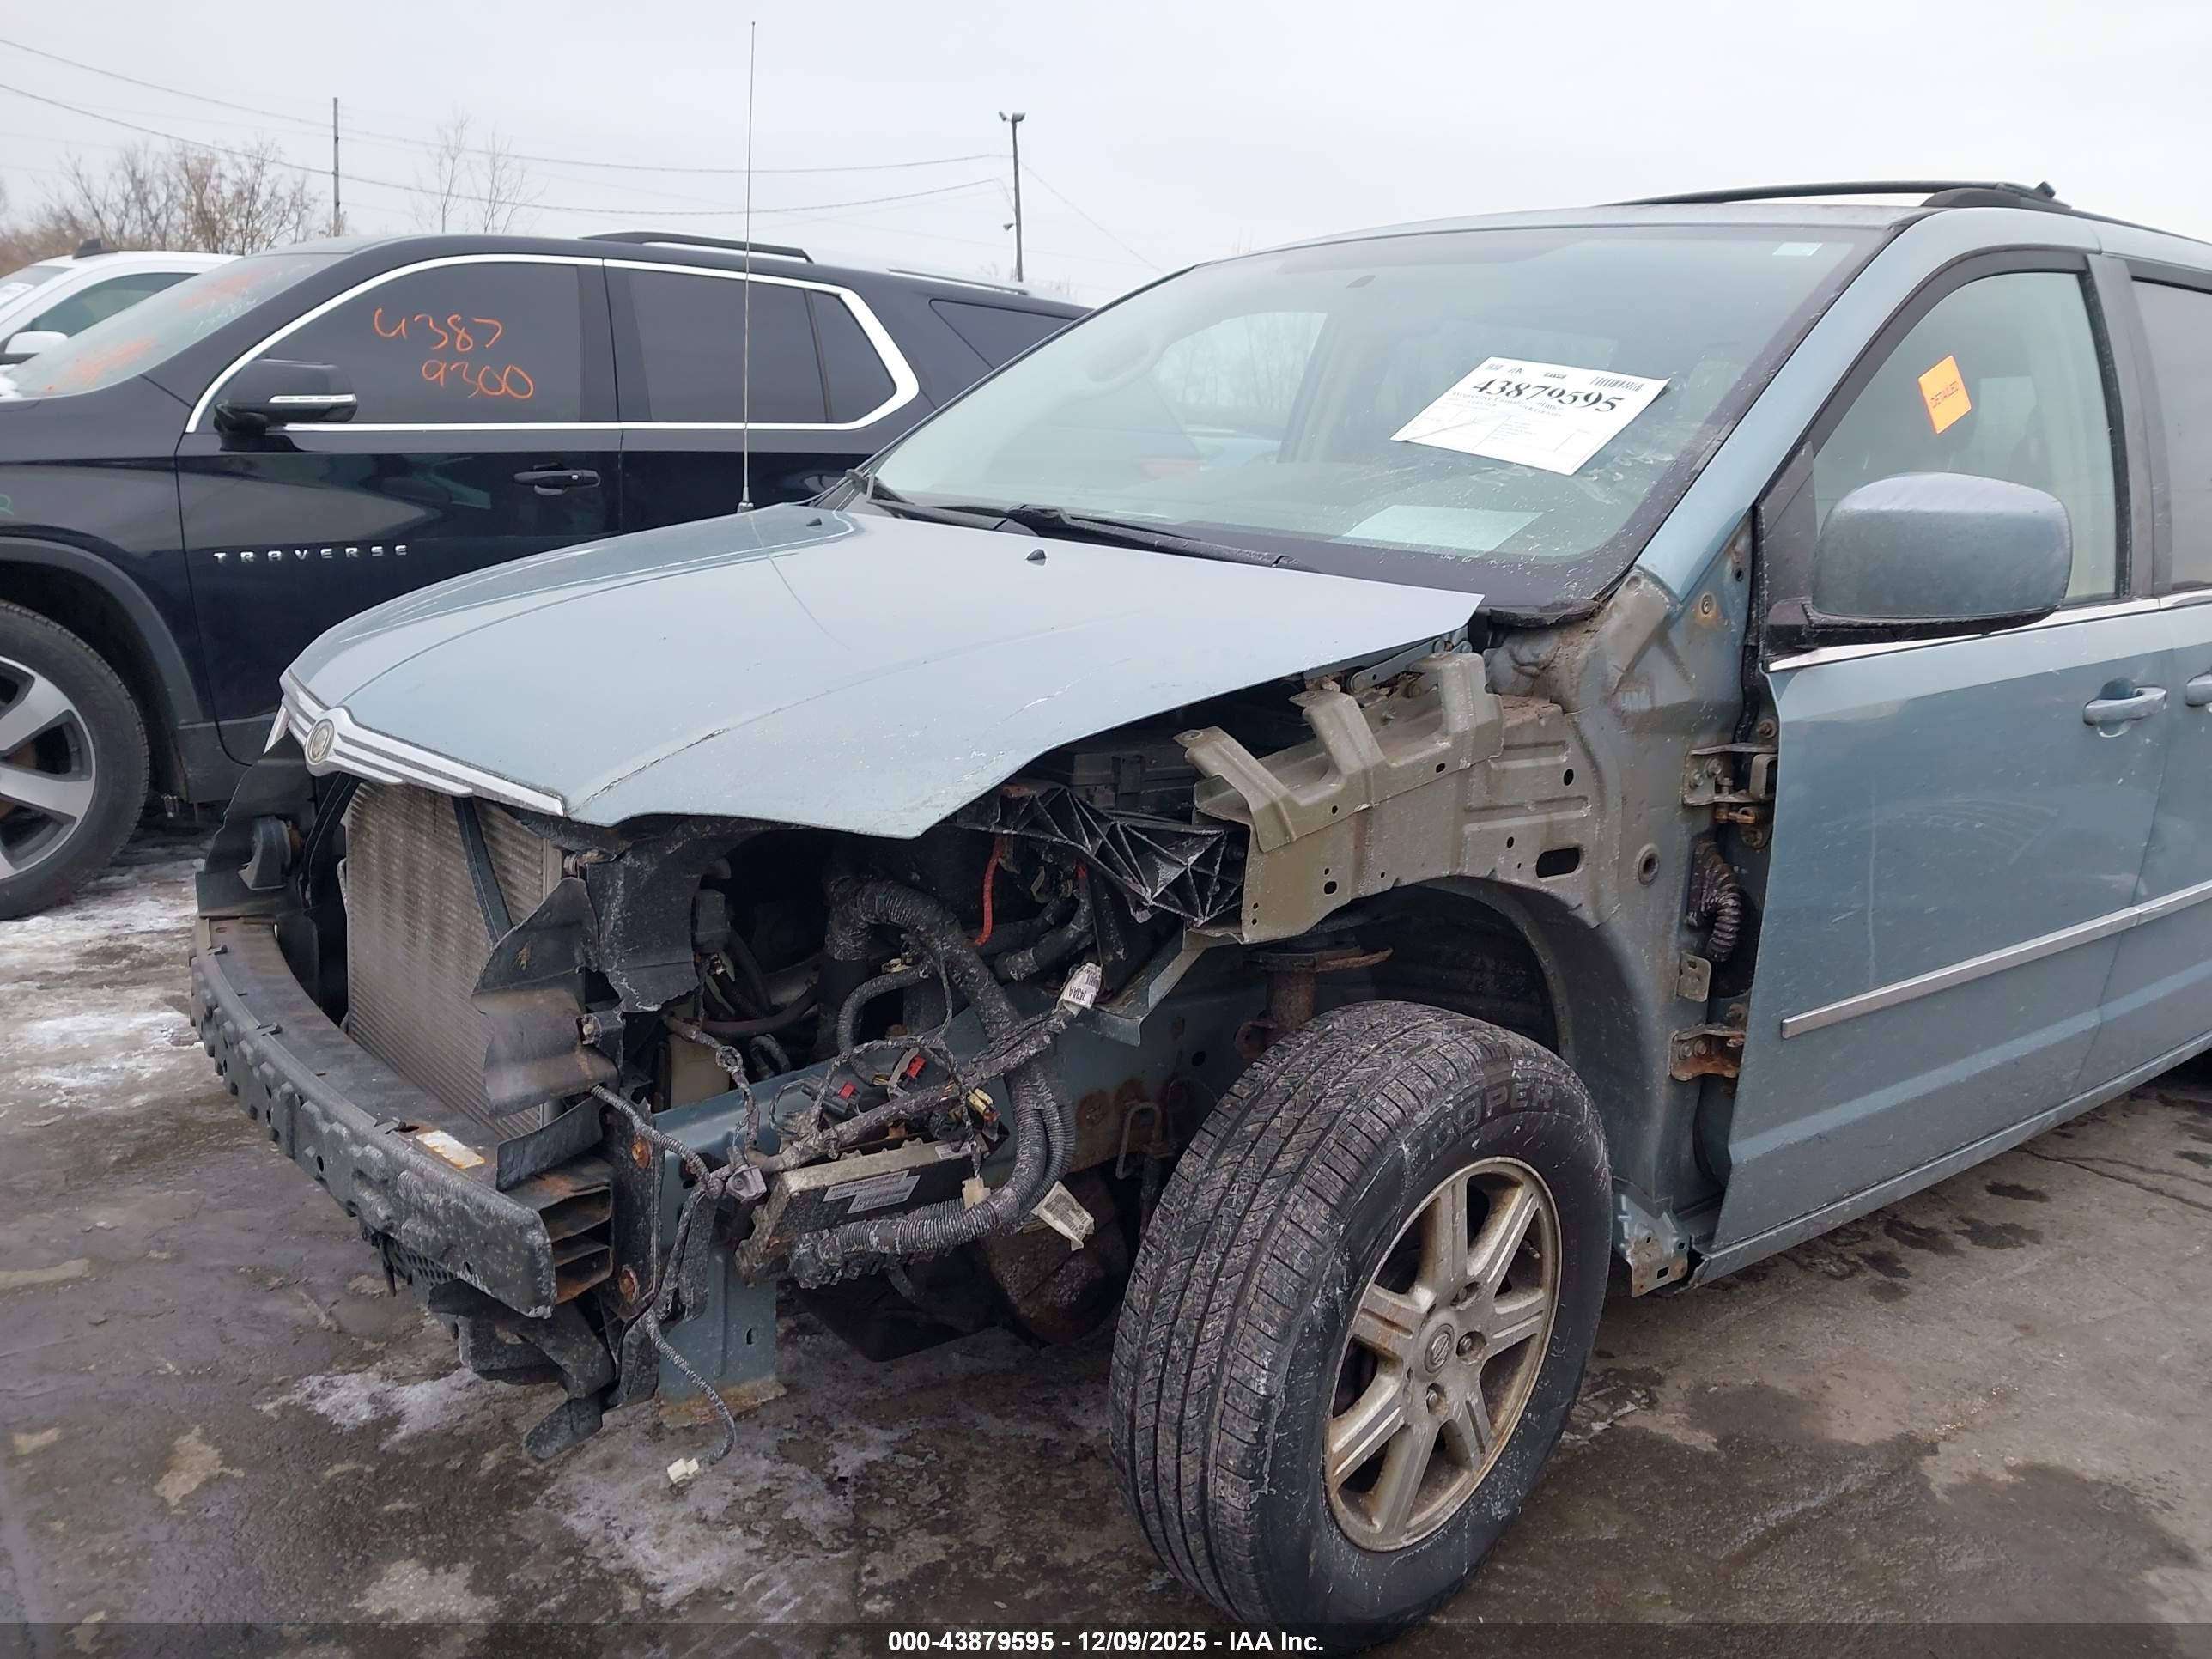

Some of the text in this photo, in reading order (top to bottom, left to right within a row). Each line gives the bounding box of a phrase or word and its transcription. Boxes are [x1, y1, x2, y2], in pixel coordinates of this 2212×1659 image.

[373, 307, 503, 353] 4387
[422, 360, 534, 398] 9300
[1472, 378, 1626, 413] 43879595
[214, 544, 408, 564] TRAVERSE
